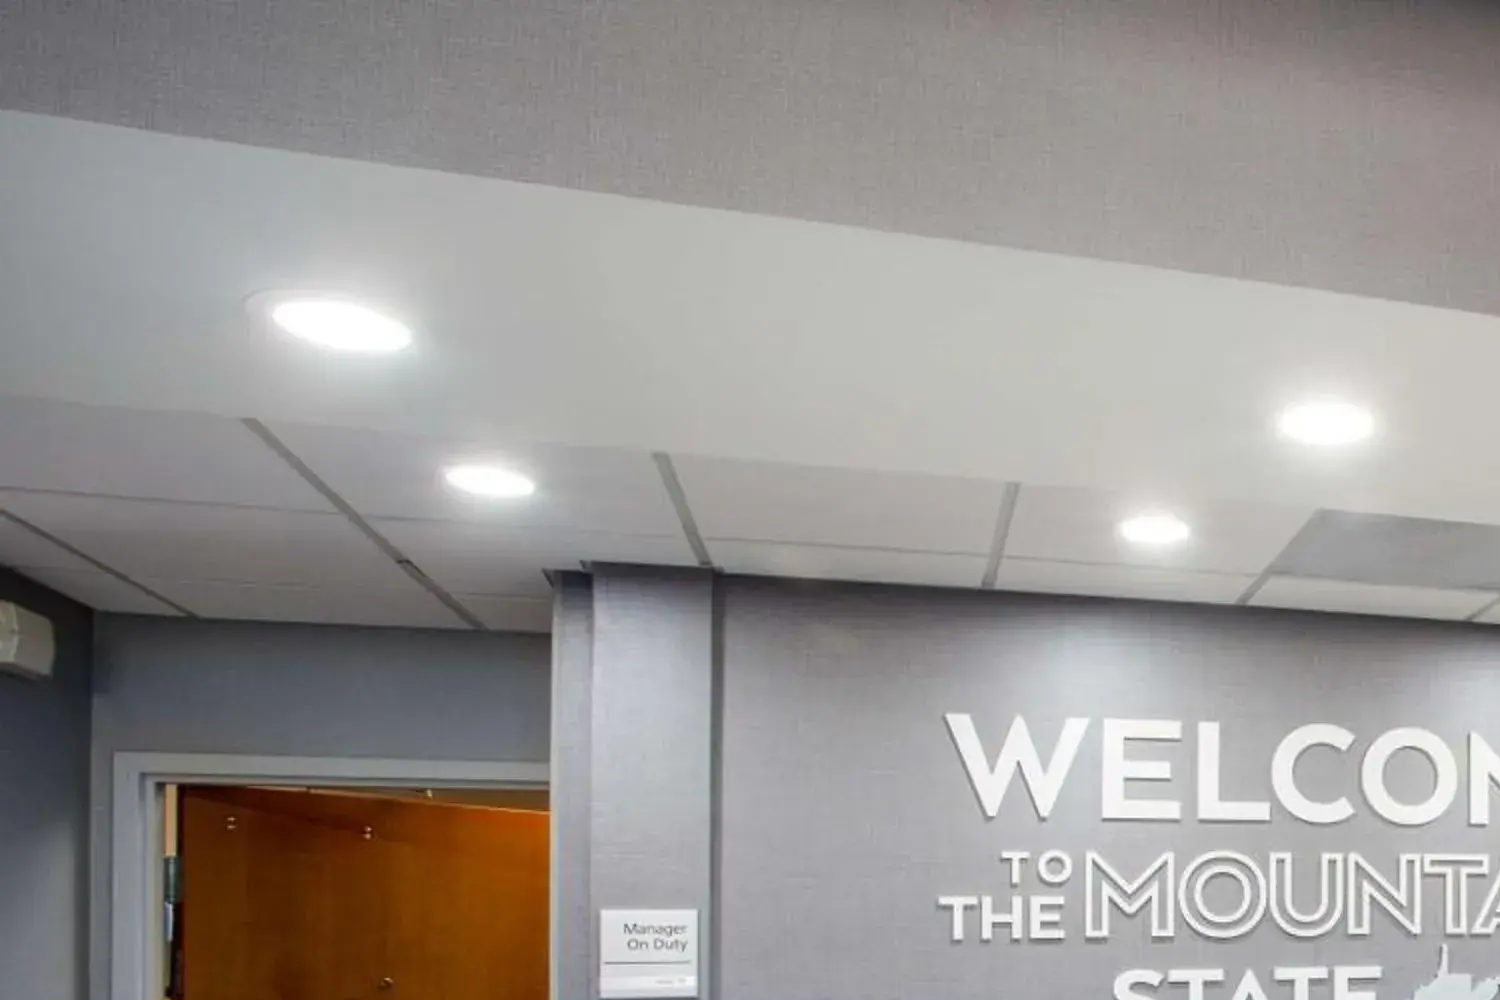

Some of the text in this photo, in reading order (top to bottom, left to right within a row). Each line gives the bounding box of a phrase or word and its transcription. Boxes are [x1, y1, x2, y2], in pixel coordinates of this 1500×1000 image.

[1000, 850, 1073, 887] TO
[623, 922, 688, 937] Manager
[938, 895, 1066, 941] THE
[627, 938, 689, 952] On Duty
